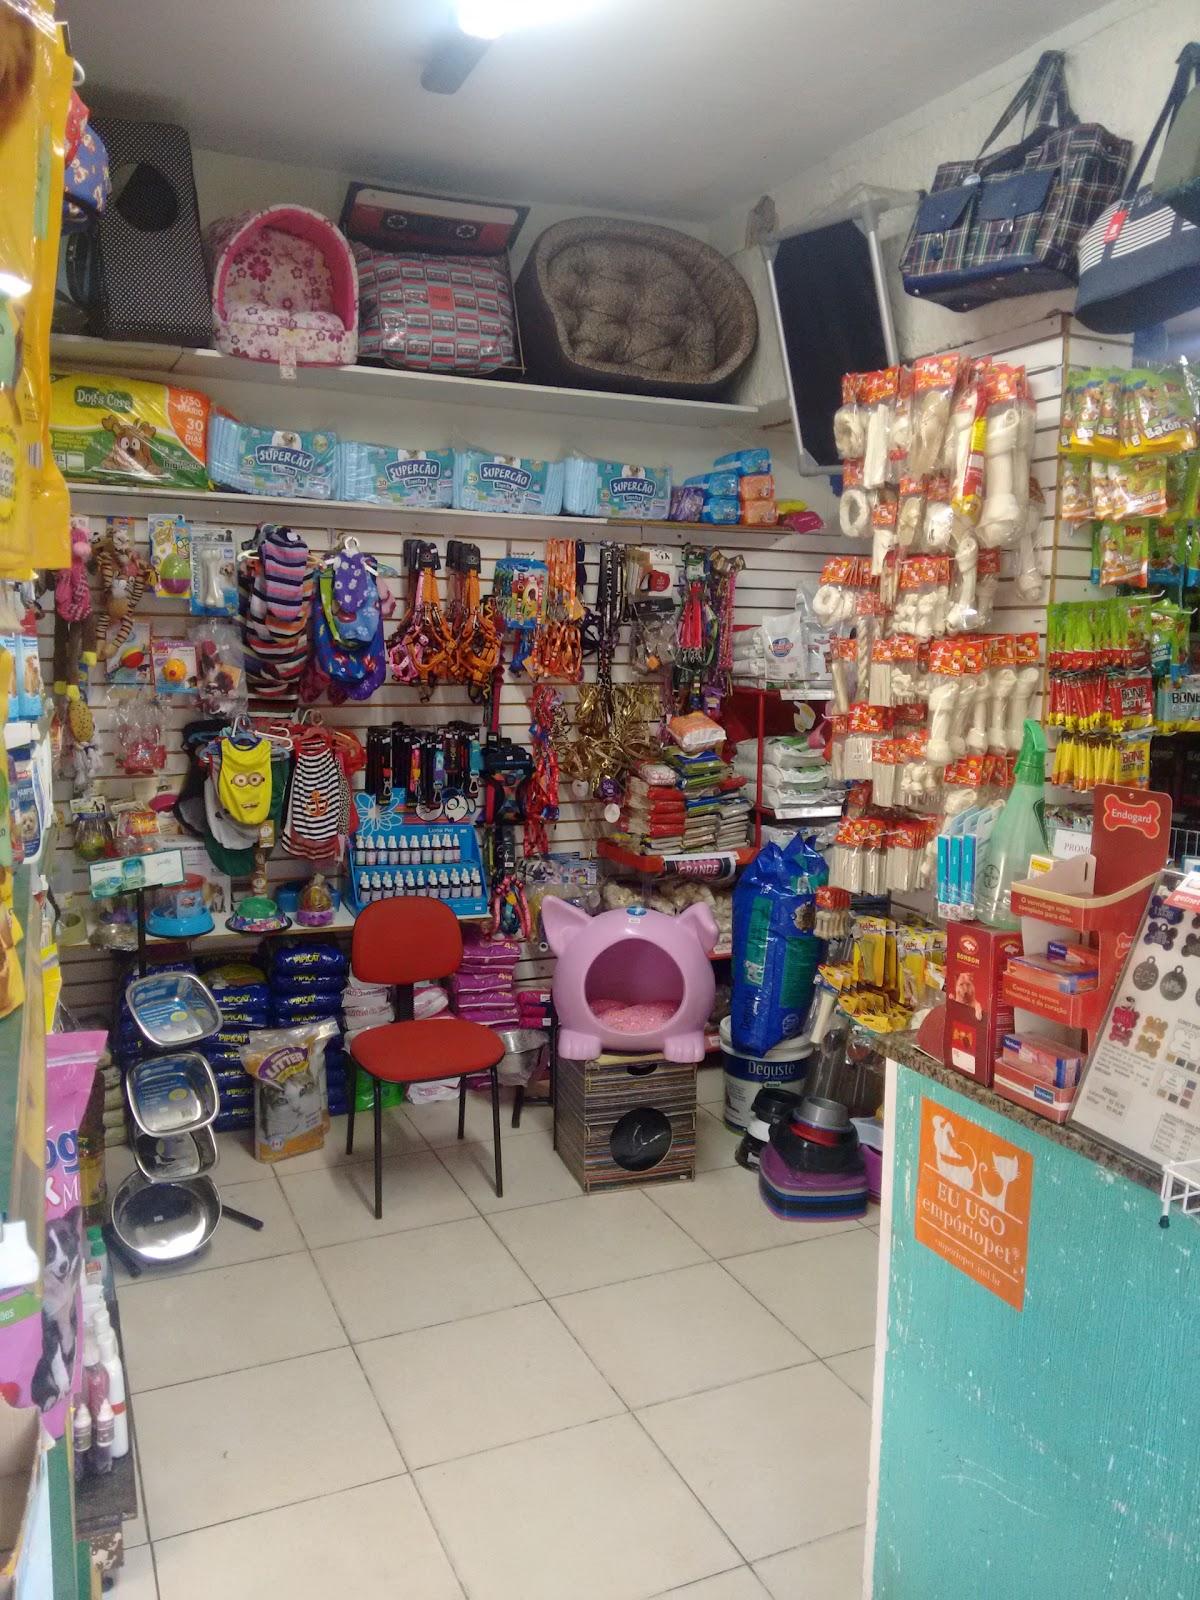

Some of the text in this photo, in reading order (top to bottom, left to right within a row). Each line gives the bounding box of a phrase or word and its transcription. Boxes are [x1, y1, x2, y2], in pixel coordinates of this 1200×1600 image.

[77, 389, 104, 406] Dog's
[187, 418, 204, 432] 30
[1143, 419, 1182, 440] Bacon
[260, 449, 311, 468] SUPERCÃO
[390, 462, 438, 478] SUPERCÃO
[483, 466, 528, 486] SUPERCÃO
[613, 481, 653, 494] SUPERCÃO
[1121, 685, 1147, 700] BONE
[1122, 750, 1145, 764] BONE
[1111, 808, 1152, 824] Endogard
[678, 864, 720, 876] GRANDE
[265, 1051, 306, 1078] LITTER
[748, 1061, 796, 1080] Deguste
[938, 1181, 1006, 1237] EU USO
